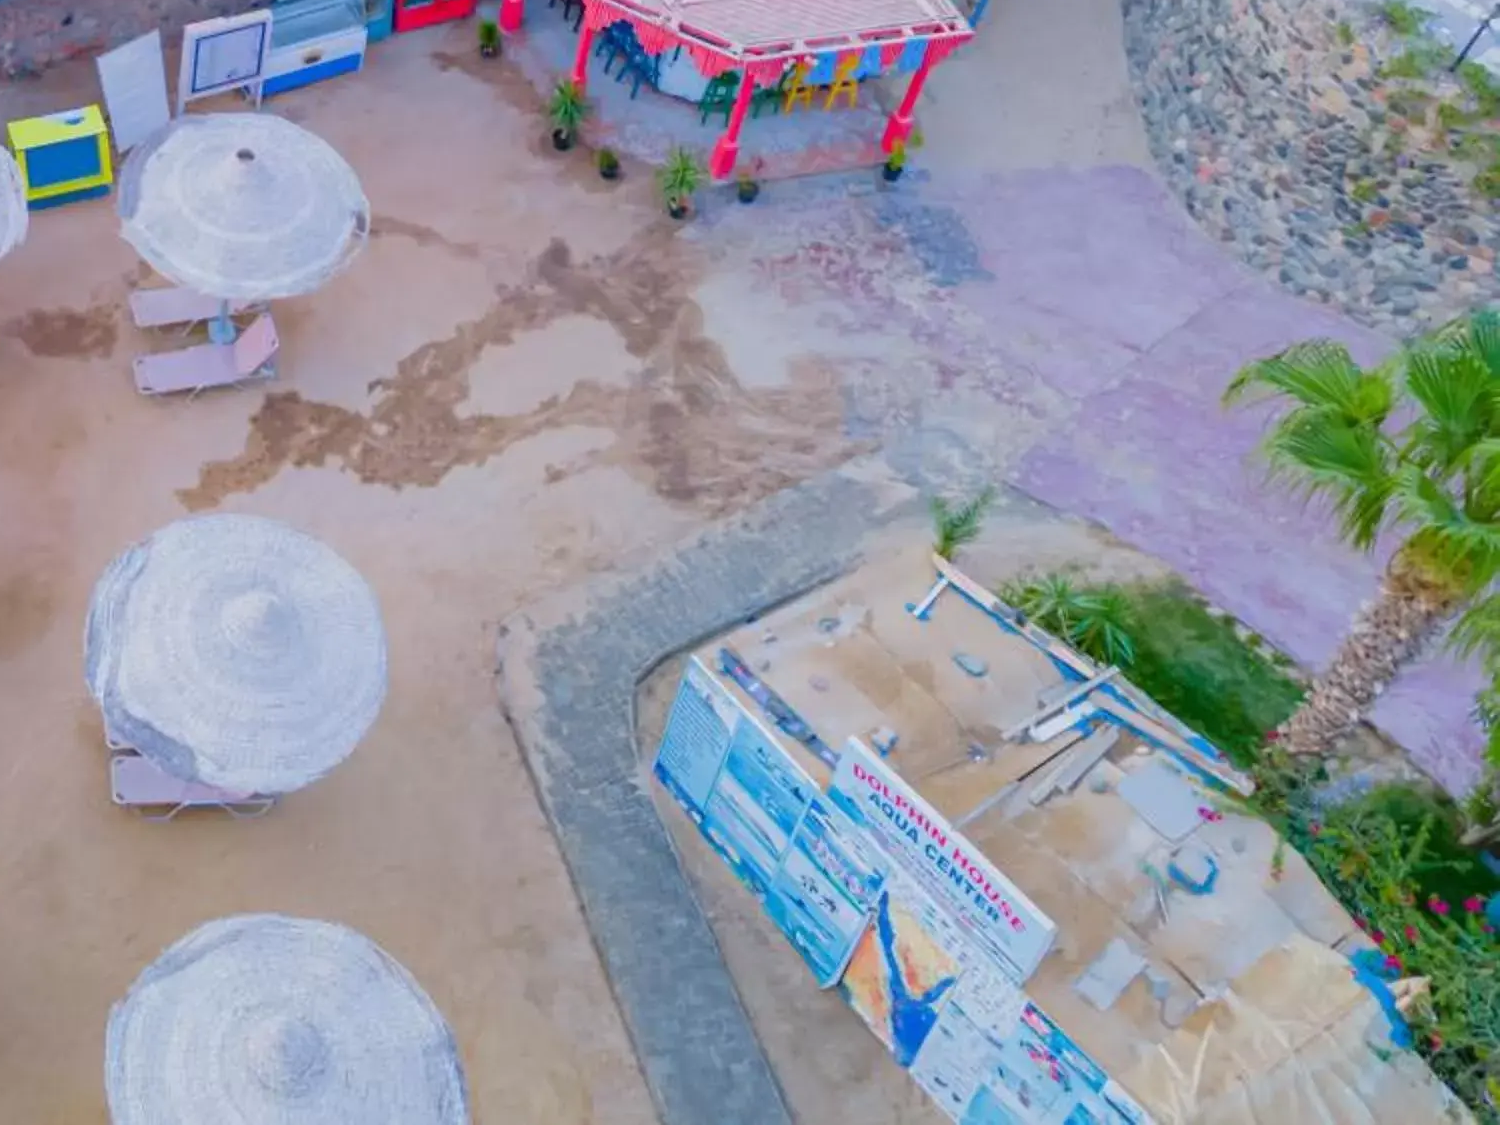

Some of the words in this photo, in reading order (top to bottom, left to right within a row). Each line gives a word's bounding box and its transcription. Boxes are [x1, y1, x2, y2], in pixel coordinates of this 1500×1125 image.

[852, 762, 949, 848] DOLPHIN
[953, 847, 1027, 934] HOUSE
[868, 792, 920, 844] AQUA
[924, 842, 1001, 924] CENTER
